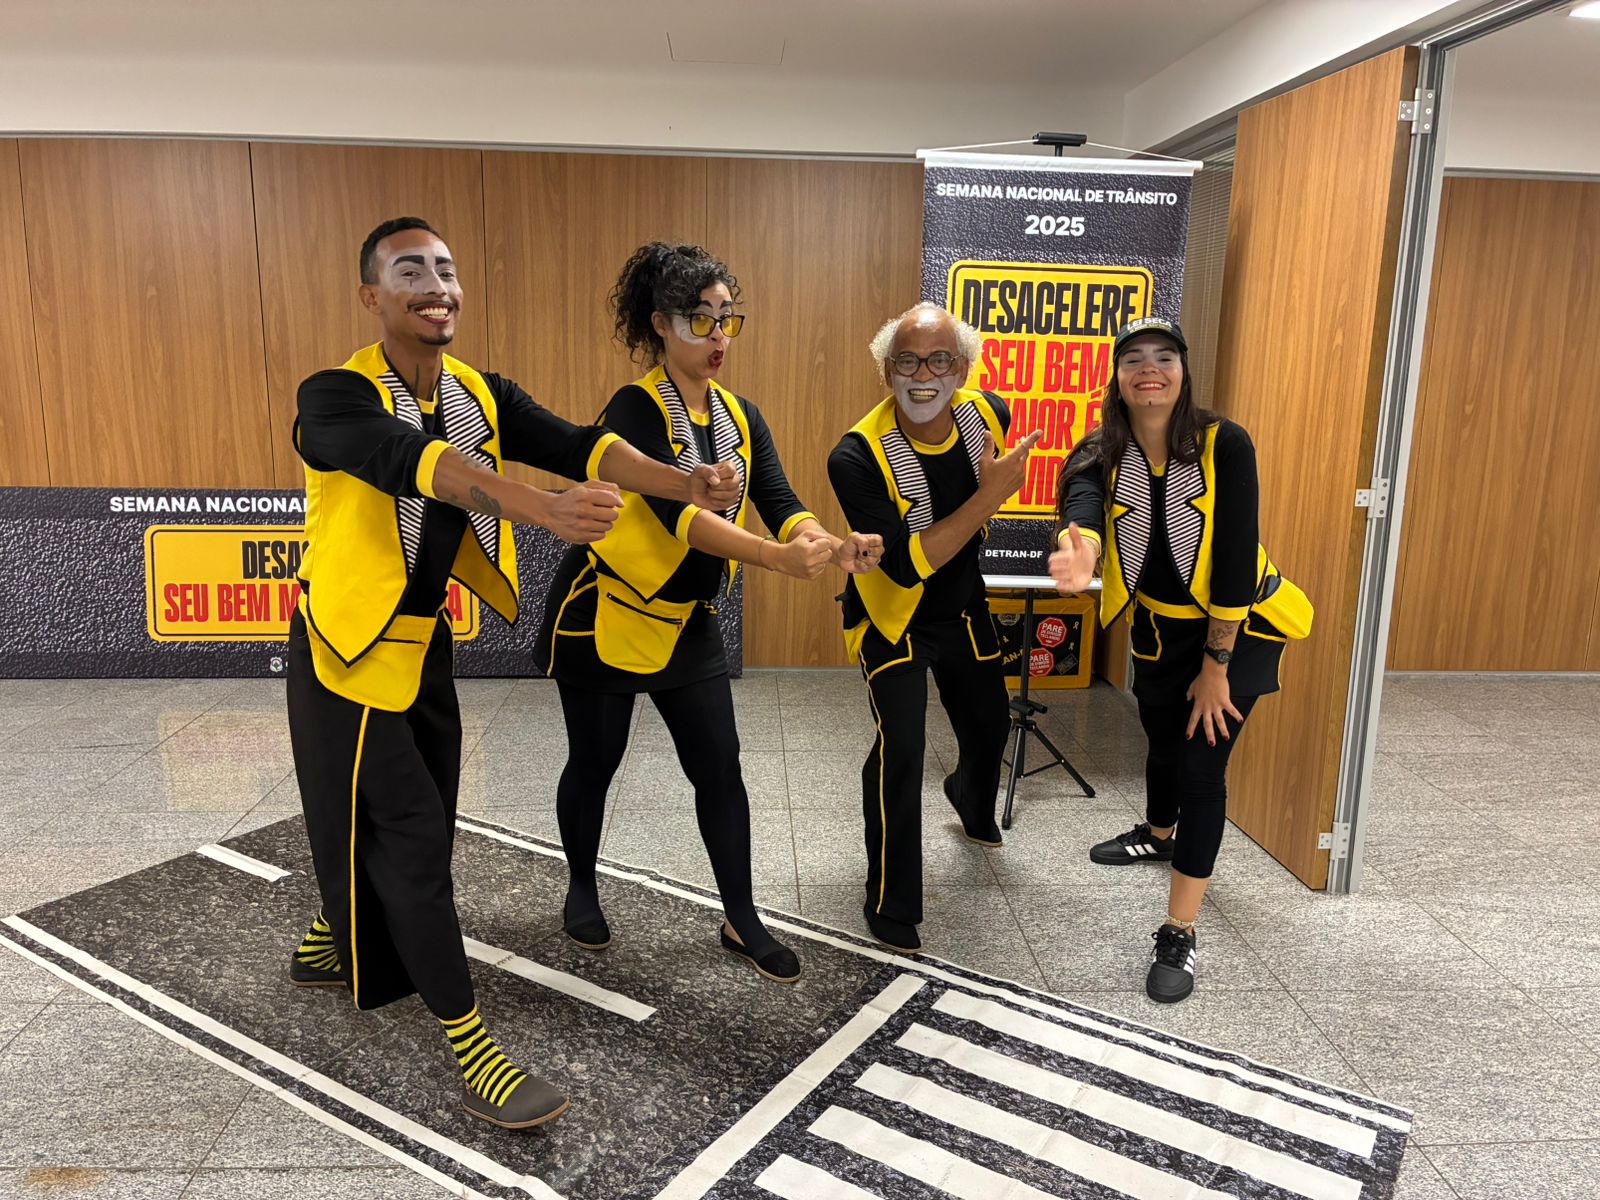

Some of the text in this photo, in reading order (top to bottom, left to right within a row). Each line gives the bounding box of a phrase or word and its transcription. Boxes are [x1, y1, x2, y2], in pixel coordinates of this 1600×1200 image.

[936, 183, 1178, 205] SEMANA NACIONAL DE TRÂNSITO
[1025, 214, 1085, 236] 2025
[962, 279, 1138, 337] DESACELERE
[1127, 318, 1143, 331] LEI
[1144, 317, 1173, 329] SECA
[979, 339, 1110, 394] SEU BEM
[1004, 398, 1076, 450] AIOR
[110, 496, 201, 513] SEMANA
[985, 549, 1043, 559] DETRAN-DF
[164, 583, 209, 622] SEU
[217, 583, 271, 622] BEM
[1042, 623, 1063, 634] PARE
